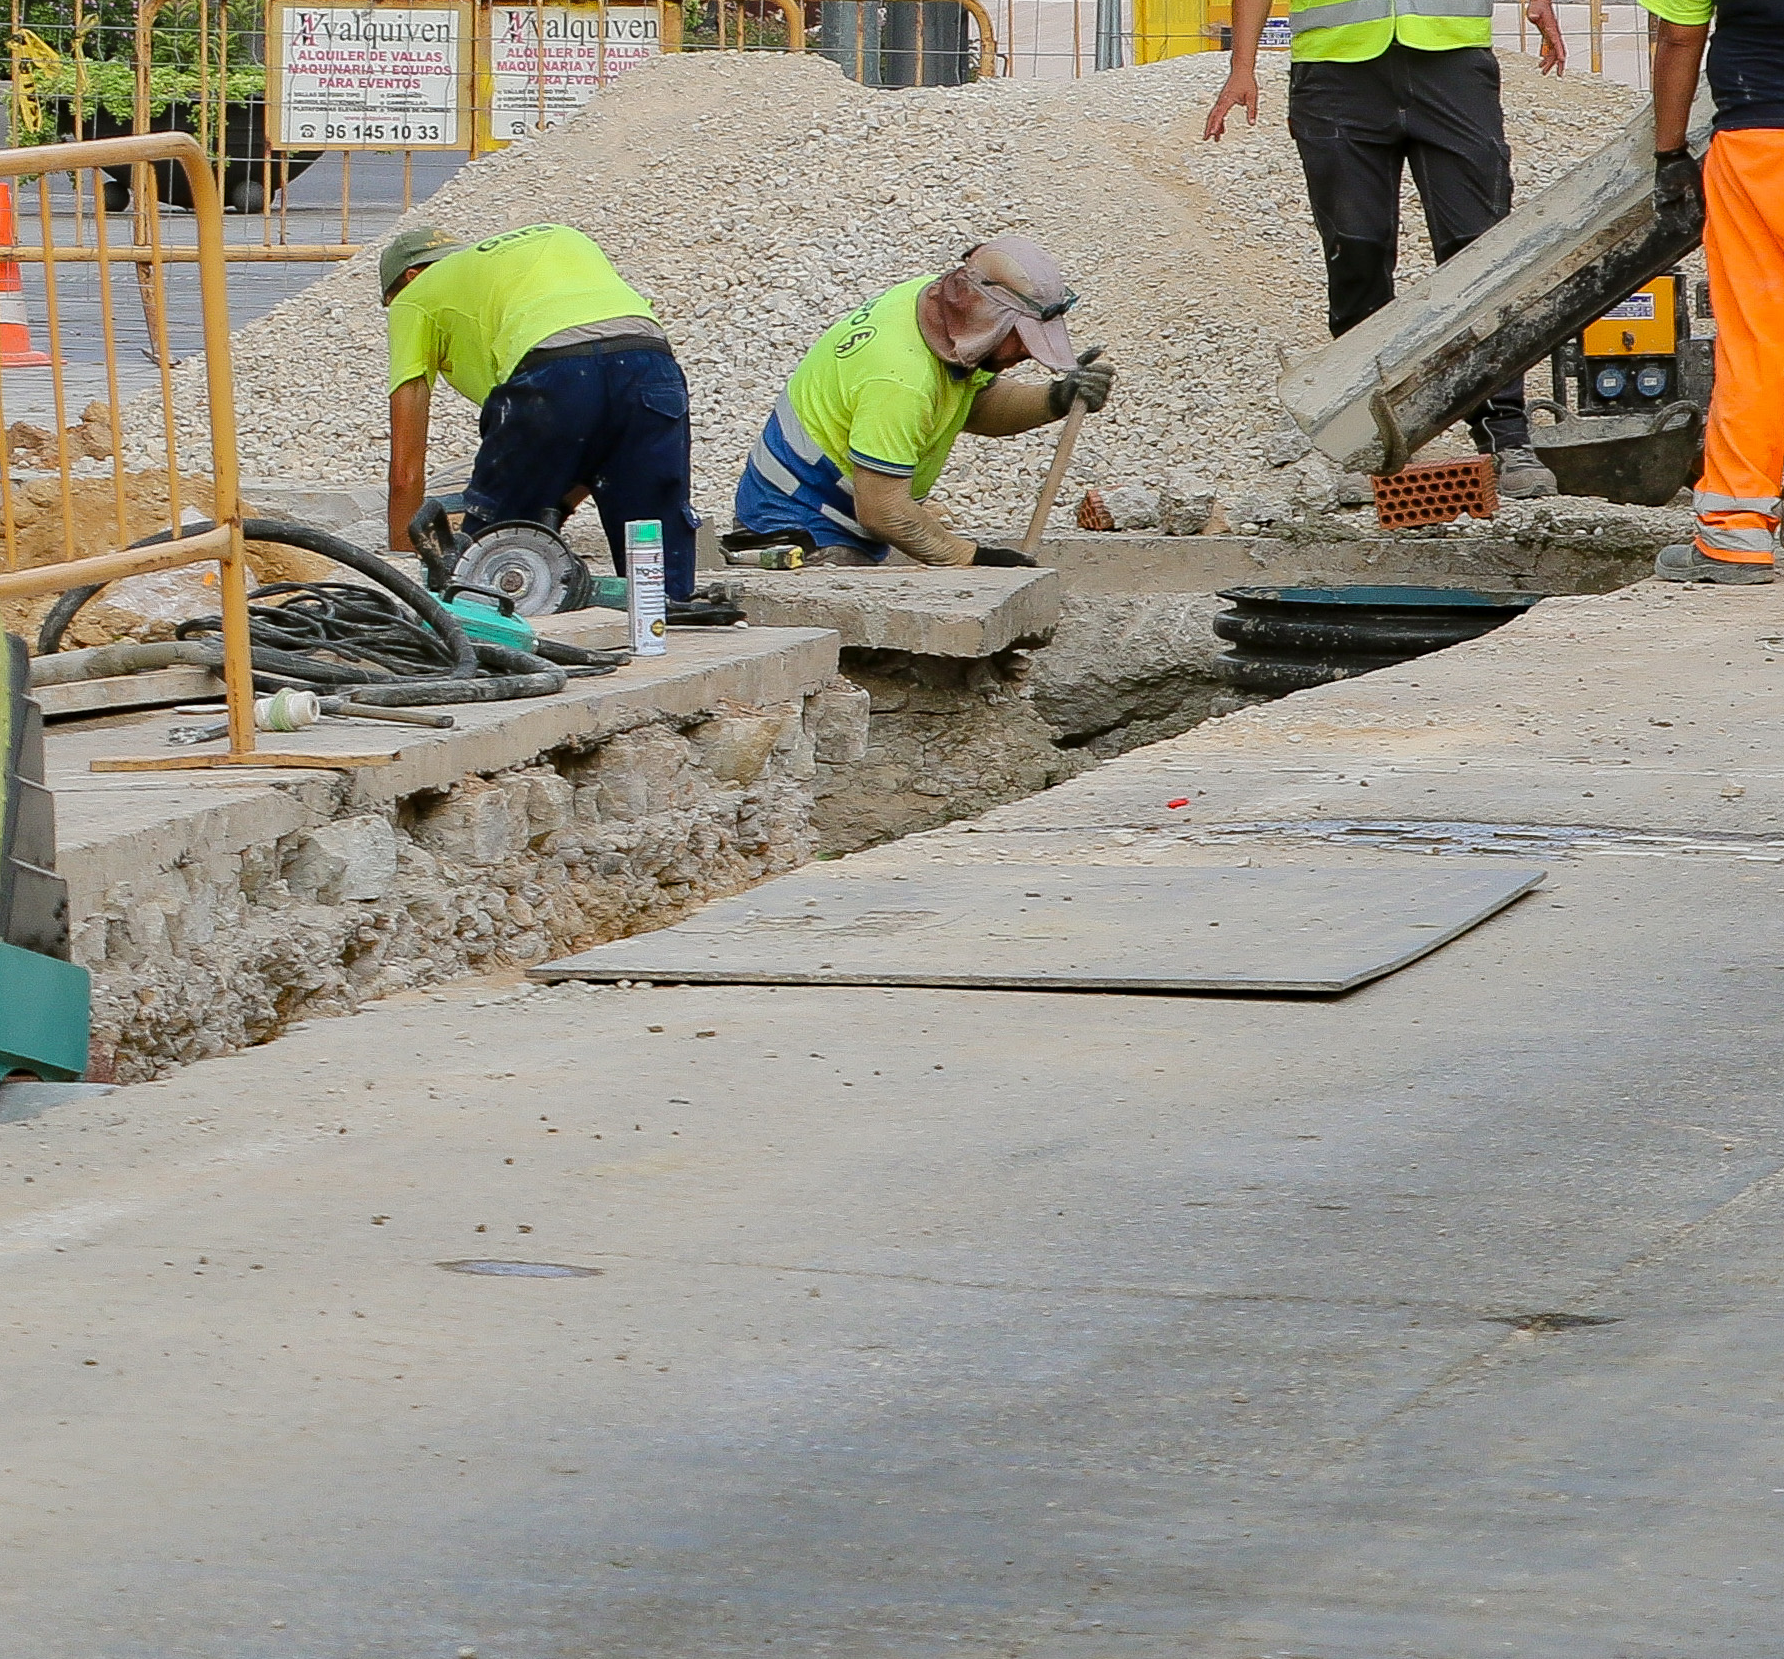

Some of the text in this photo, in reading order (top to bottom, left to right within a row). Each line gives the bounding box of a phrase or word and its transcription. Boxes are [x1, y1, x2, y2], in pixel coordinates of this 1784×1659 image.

[324, 13, 450, 49] valquiven
[297, 50, 443, 63] ALQUILER DE VALLAS
[577, 48, 595, 59] DE
[288, 63, 452, 76] MAQUINARIA Y EQUIPOS
[588, 61, 596, 72] Y
[318, 78, 421, 89] PARA EVENTOS
[326, 124, 439, 140] 96 145 10 33
